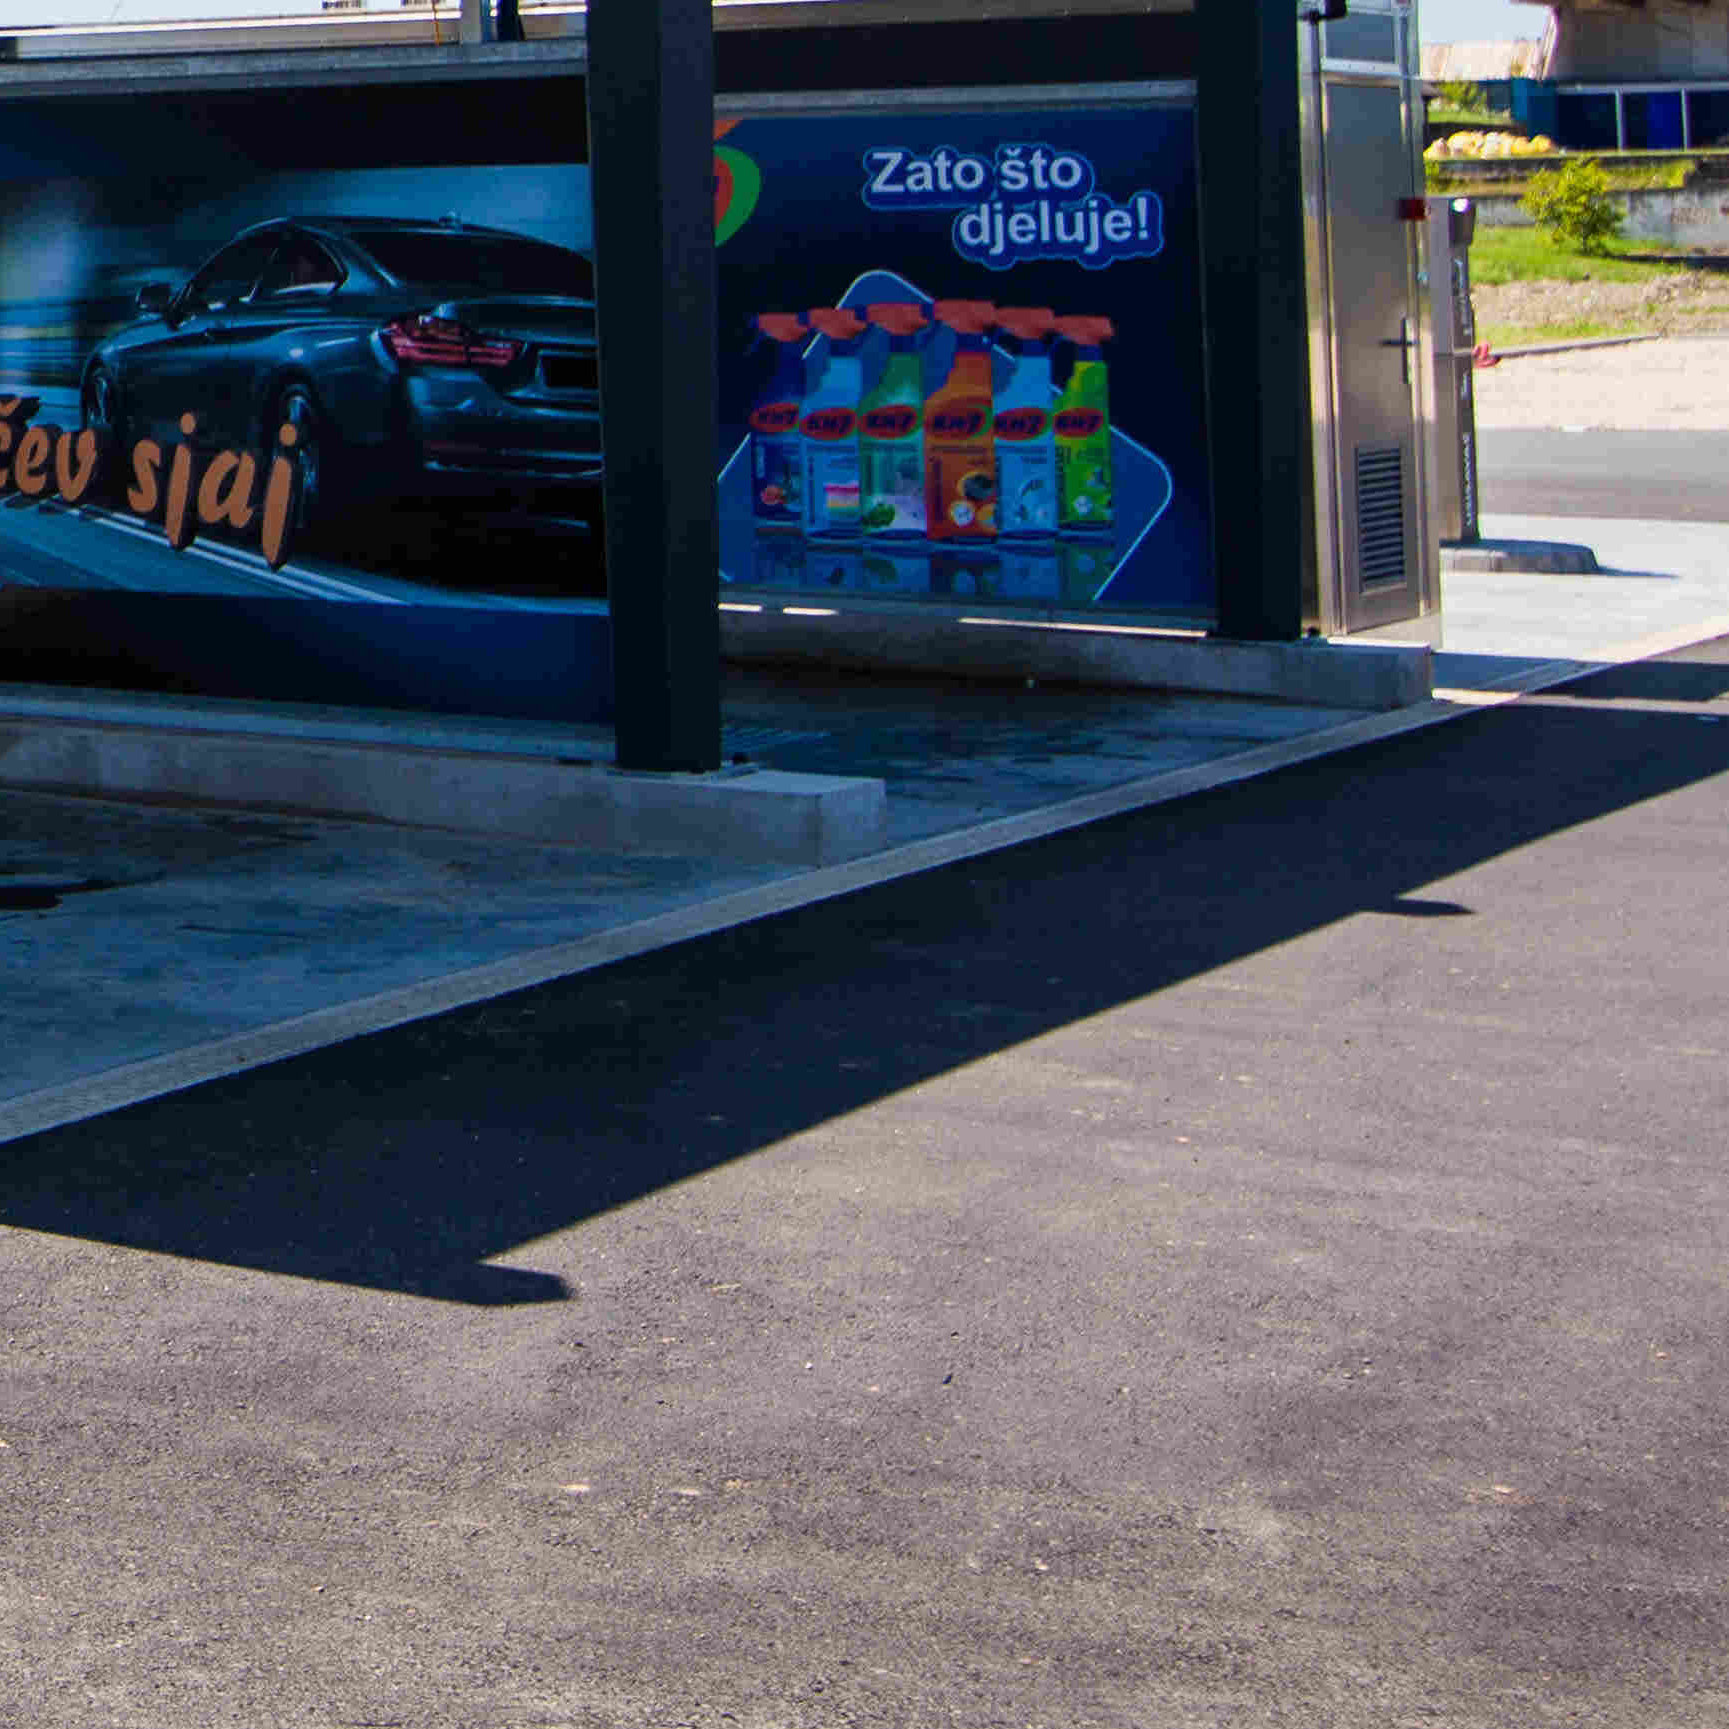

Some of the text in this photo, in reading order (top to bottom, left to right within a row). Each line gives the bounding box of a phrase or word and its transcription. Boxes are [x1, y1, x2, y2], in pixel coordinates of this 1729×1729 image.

[870, 147, 1082, 193] Zato što
[959, 197, 1149, 255] djeluje!
[127, 411, 293, 568] sjaj
